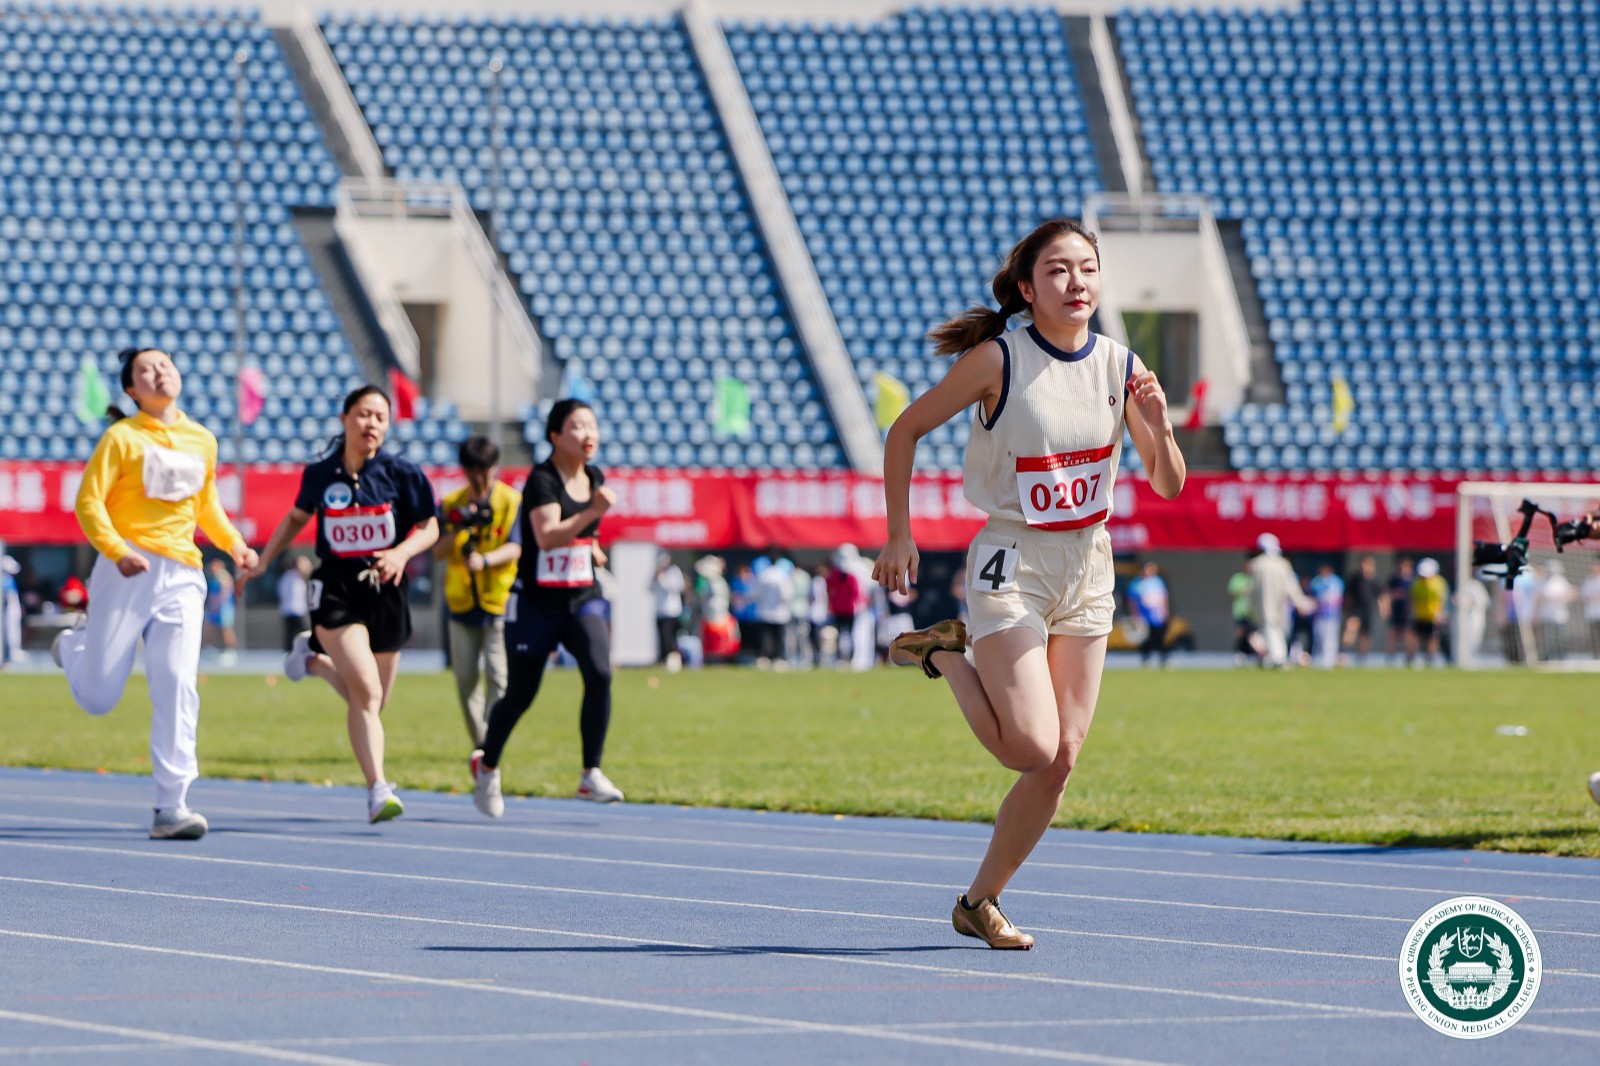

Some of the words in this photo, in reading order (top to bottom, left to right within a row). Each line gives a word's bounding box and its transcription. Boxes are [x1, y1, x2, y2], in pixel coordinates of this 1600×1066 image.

[1030, 472, 1101, 512] 0207
[332, 522, 389, 544] 0301
[979, 548, 1006, 590] 4
